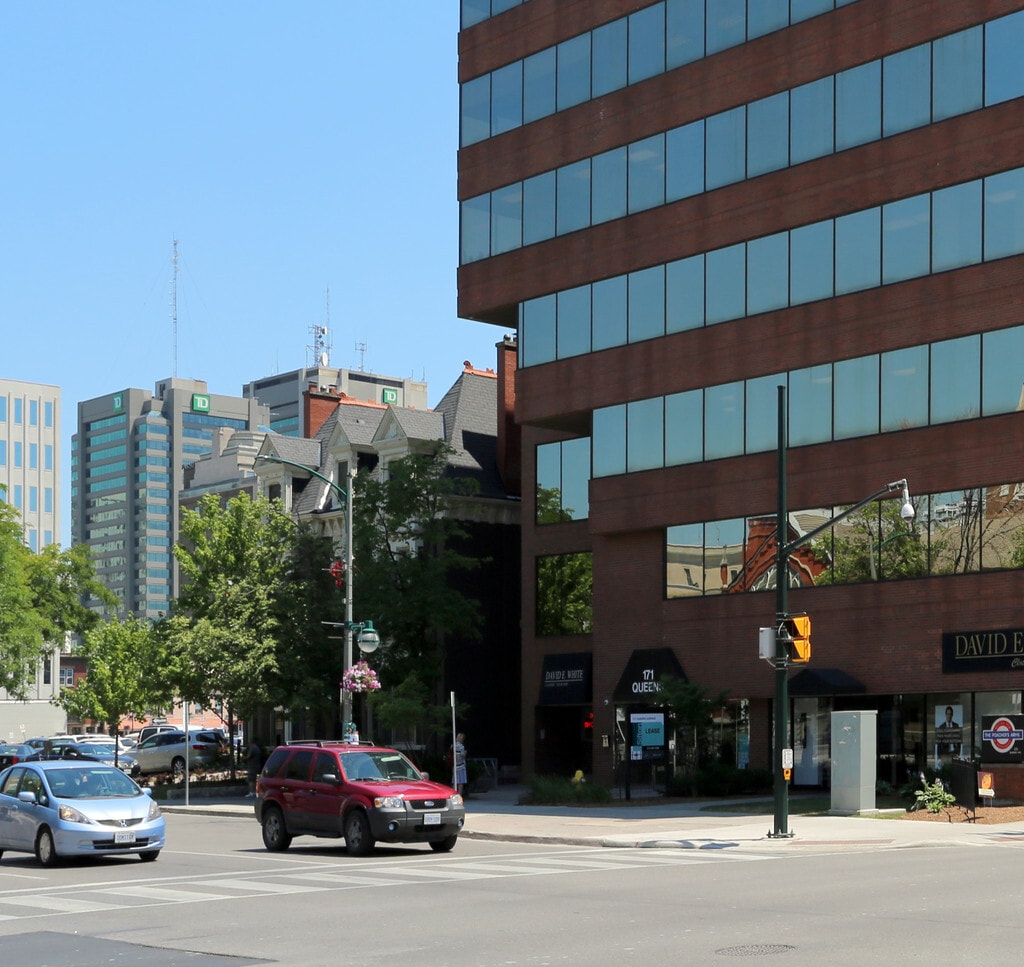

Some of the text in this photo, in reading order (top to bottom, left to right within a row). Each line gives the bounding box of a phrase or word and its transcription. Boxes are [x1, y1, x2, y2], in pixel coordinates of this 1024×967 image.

[113, 395, 121, 408] TD
[195, 396, 209, 409] TD
[384, 390, 397, 402] TD
[955, 634, 1007, 657] DAVID
[642, 669, 654, 681] 171
